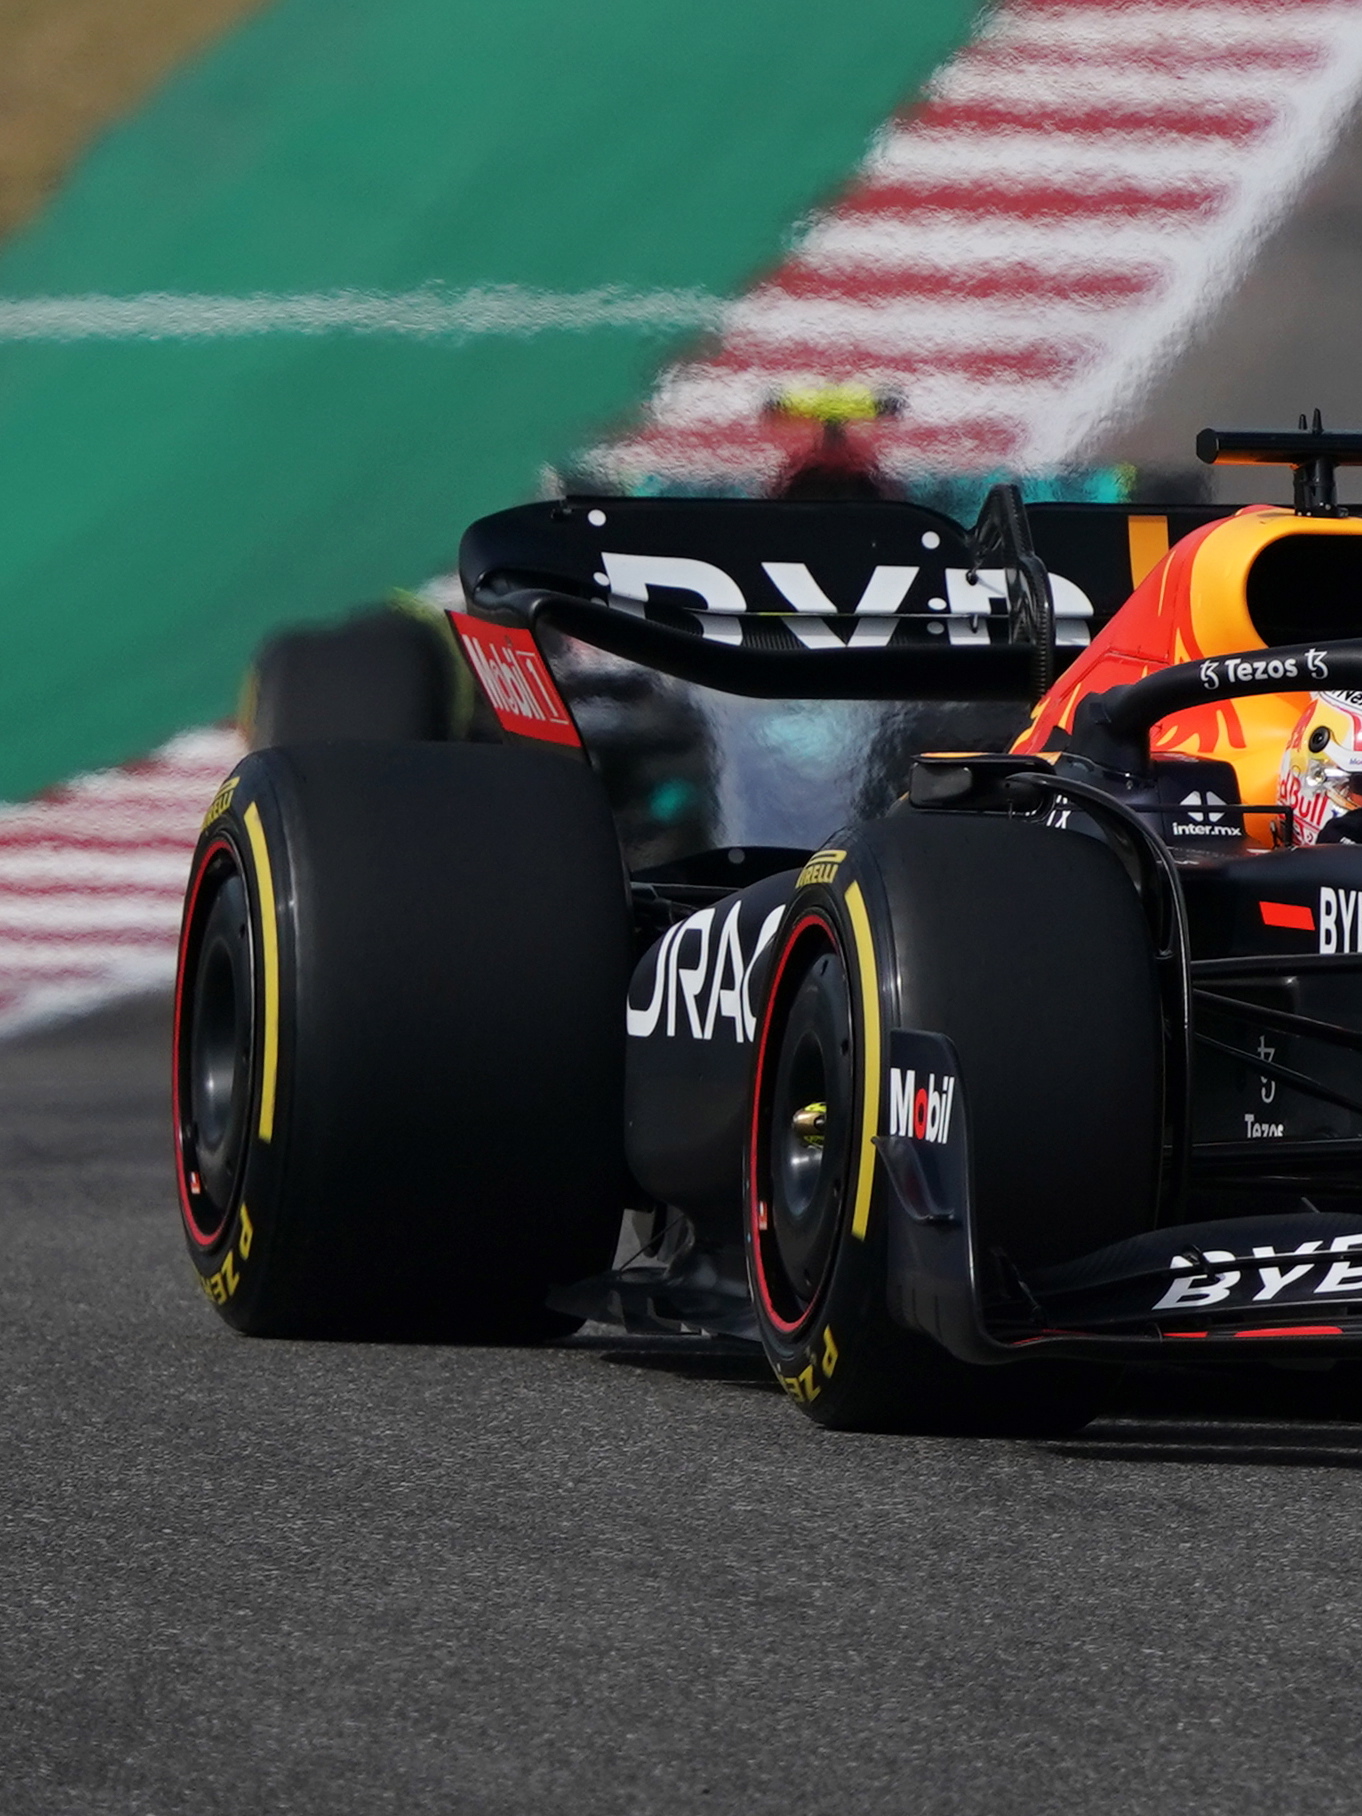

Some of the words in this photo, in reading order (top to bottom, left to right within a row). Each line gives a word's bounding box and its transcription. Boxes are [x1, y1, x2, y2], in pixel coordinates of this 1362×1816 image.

[461, 634, 546, 722] Mobil
[1224, 658, 1299, 683] Tezos
[1172, 822, 1242, 836] inter.mx
[889, 1067, 955, 1144] Mobil
